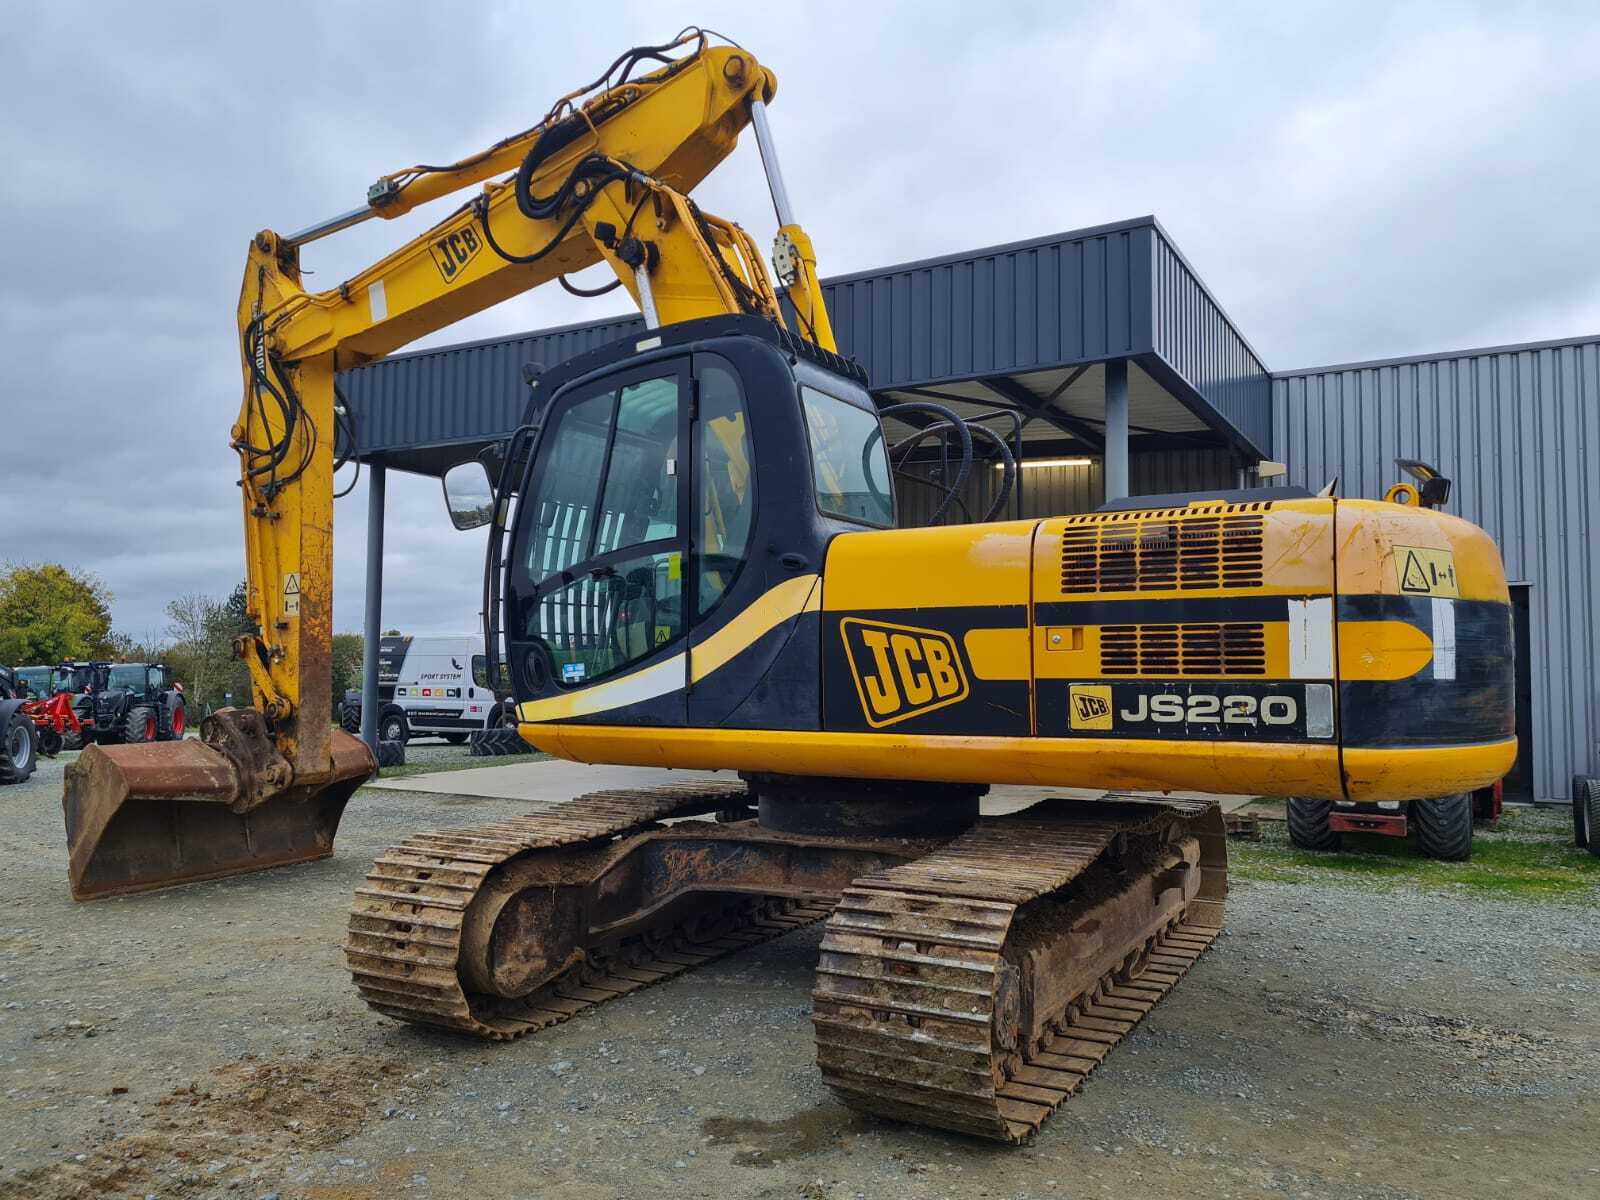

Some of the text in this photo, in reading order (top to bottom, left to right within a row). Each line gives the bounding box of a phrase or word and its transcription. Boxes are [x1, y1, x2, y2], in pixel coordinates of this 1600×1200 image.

[436, 228, 478, 277] JCB
[861, 630, 959, 715] JCB
[1078, 696, 1106, 718] JCB
[1120, 694, 1297, 725] JS220
